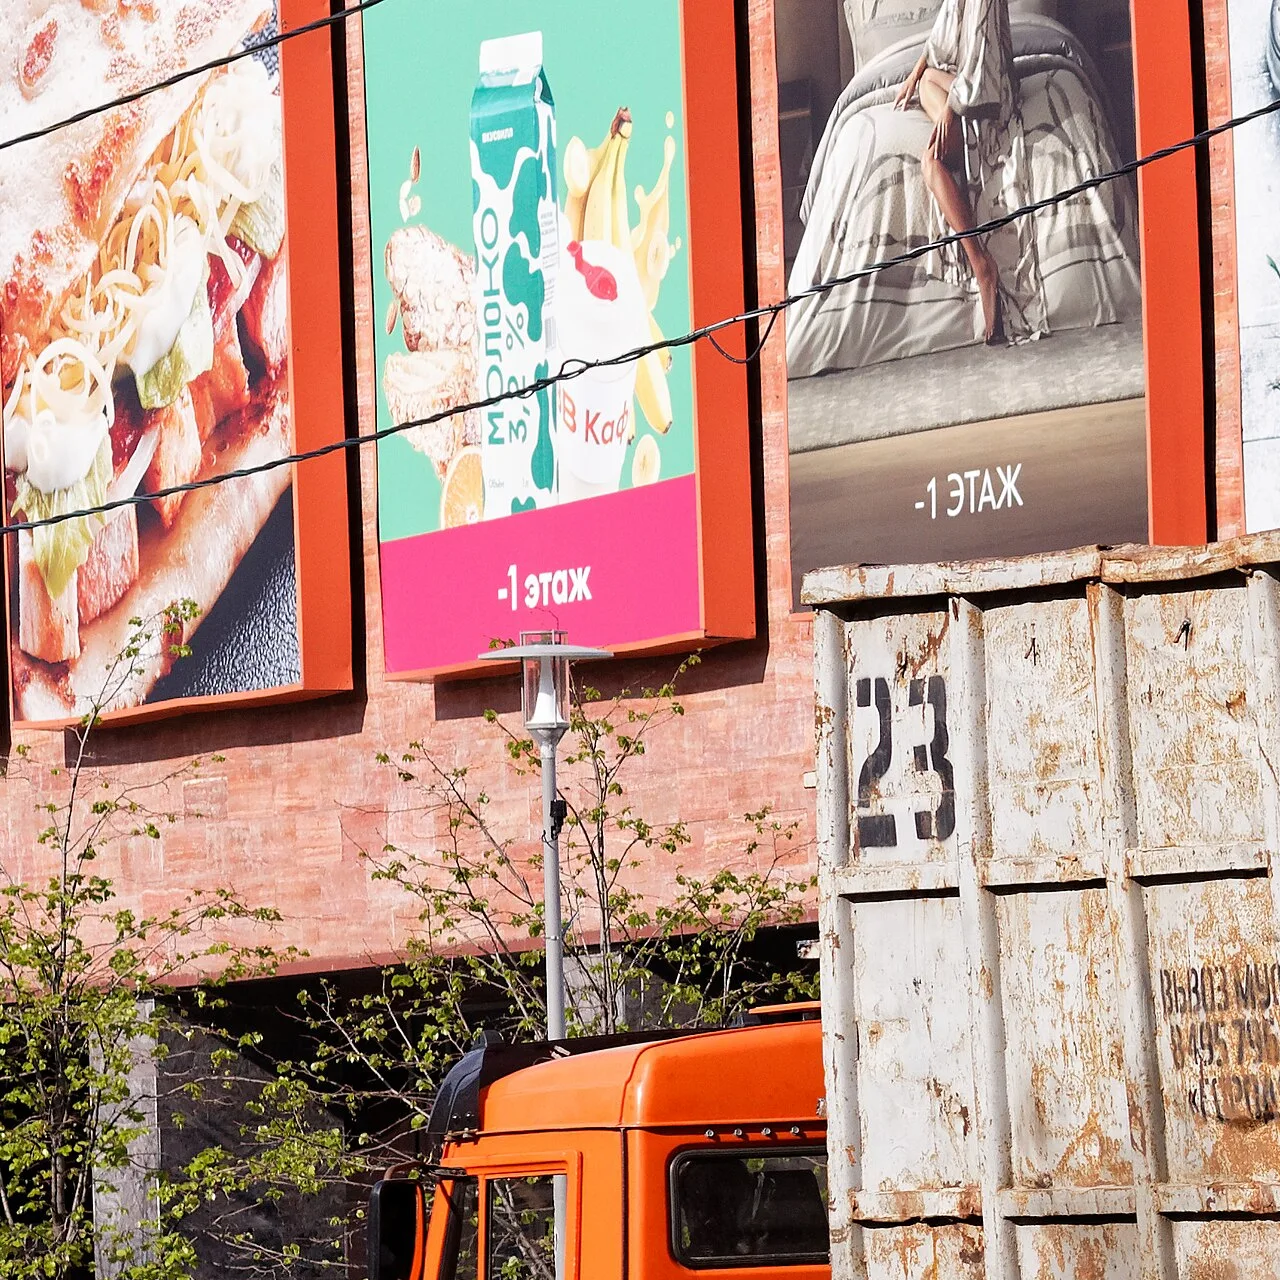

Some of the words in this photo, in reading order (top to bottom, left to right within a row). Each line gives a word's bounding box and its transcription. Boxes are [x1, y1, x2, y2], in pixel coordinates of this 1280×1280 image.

[480, 207, 505, 446] МОЛОКО
[914, 476, 937, 520] -1
[946, 463, 1024, 517] ЭТАЖ
[497, 564, 518, 611] -1
[524, 566, 593, 609] этаж
[856, 675, 957, 848] 23
